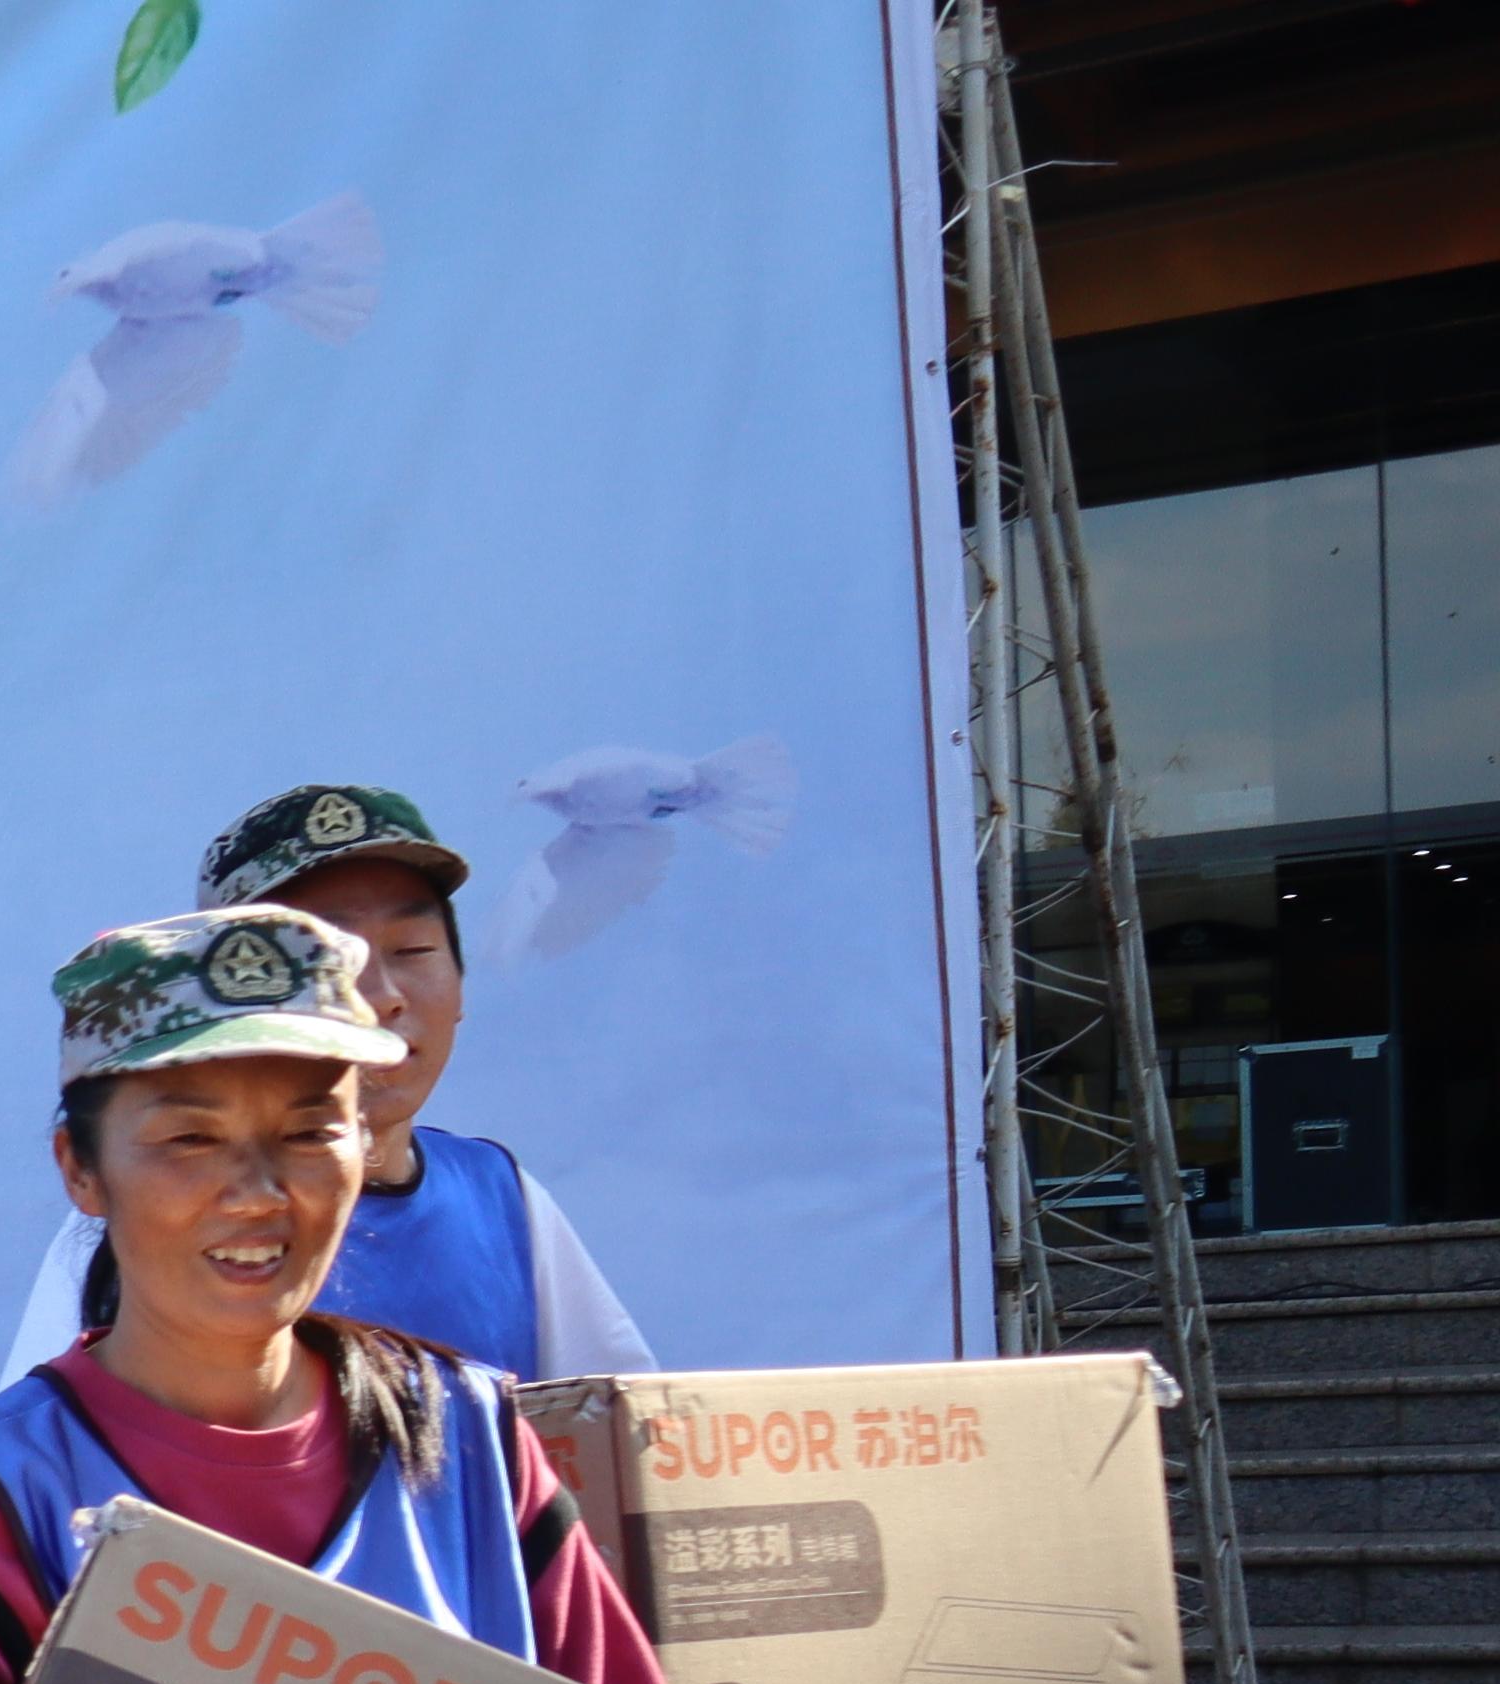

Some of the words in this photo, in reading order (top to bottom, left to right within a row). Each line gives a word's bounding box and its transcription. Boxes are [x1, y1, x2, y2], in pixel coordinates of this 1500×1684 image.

[652, 1409, 842, 1481] SUPOR
[852, 1406, 986, 1469] 苏泊尔
[664, 1522, 794, 1574] 溢彩系列
